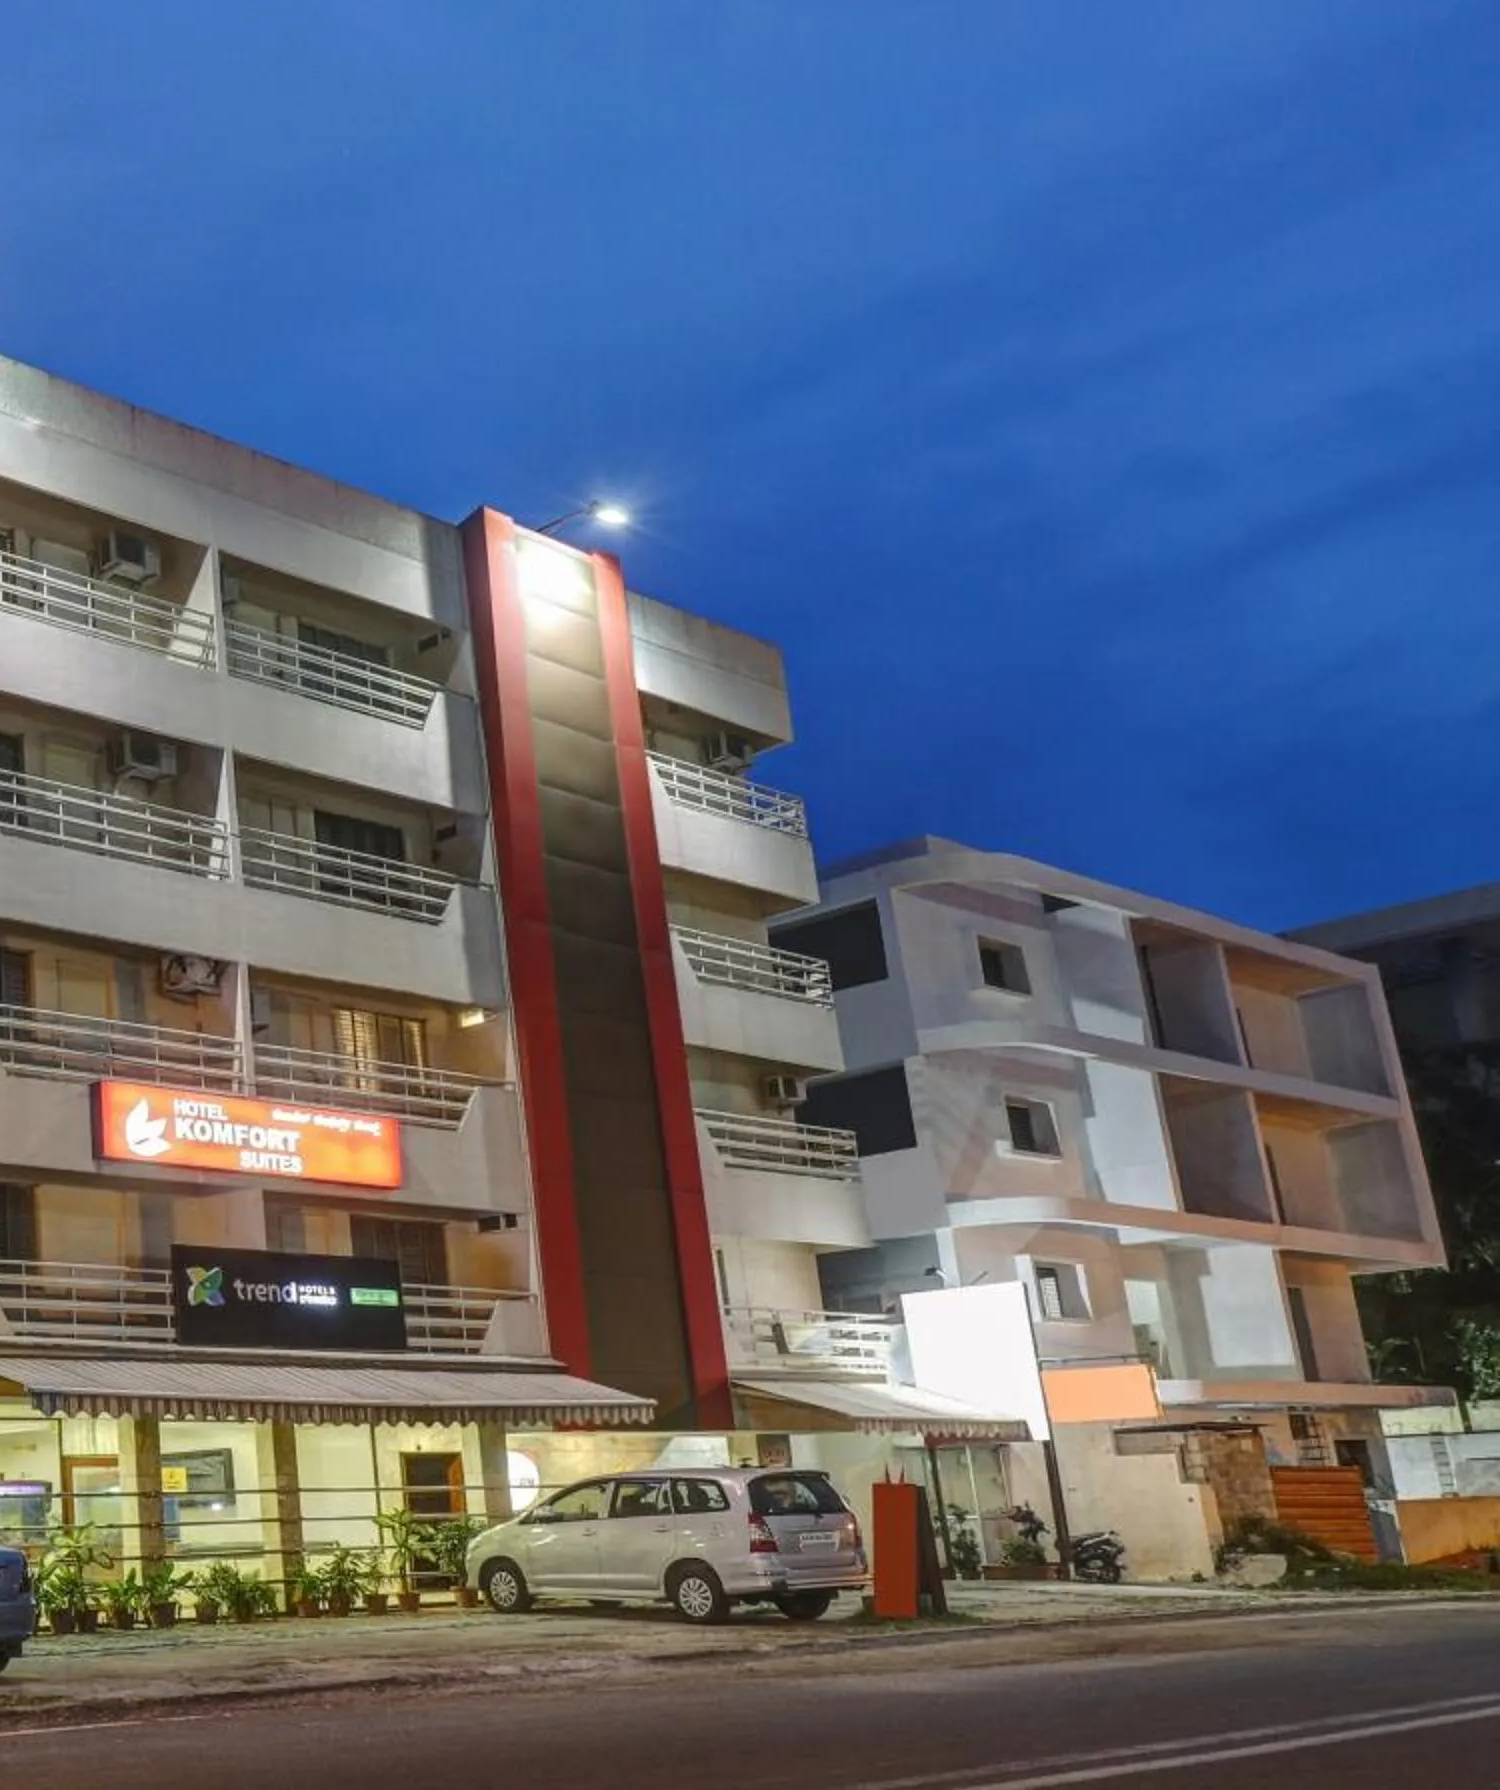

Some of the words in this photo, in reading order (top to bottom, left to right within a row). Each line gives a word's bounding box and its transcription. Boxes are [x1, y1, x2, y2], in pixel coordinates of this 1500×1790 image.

[174, 1099, 227, 1119] HOTEL
[175, 1118, 300, 1152] KOMFORT
[240, 1151, 302, 1173] SUITES
[233, 1279, 297, 1303] trend
